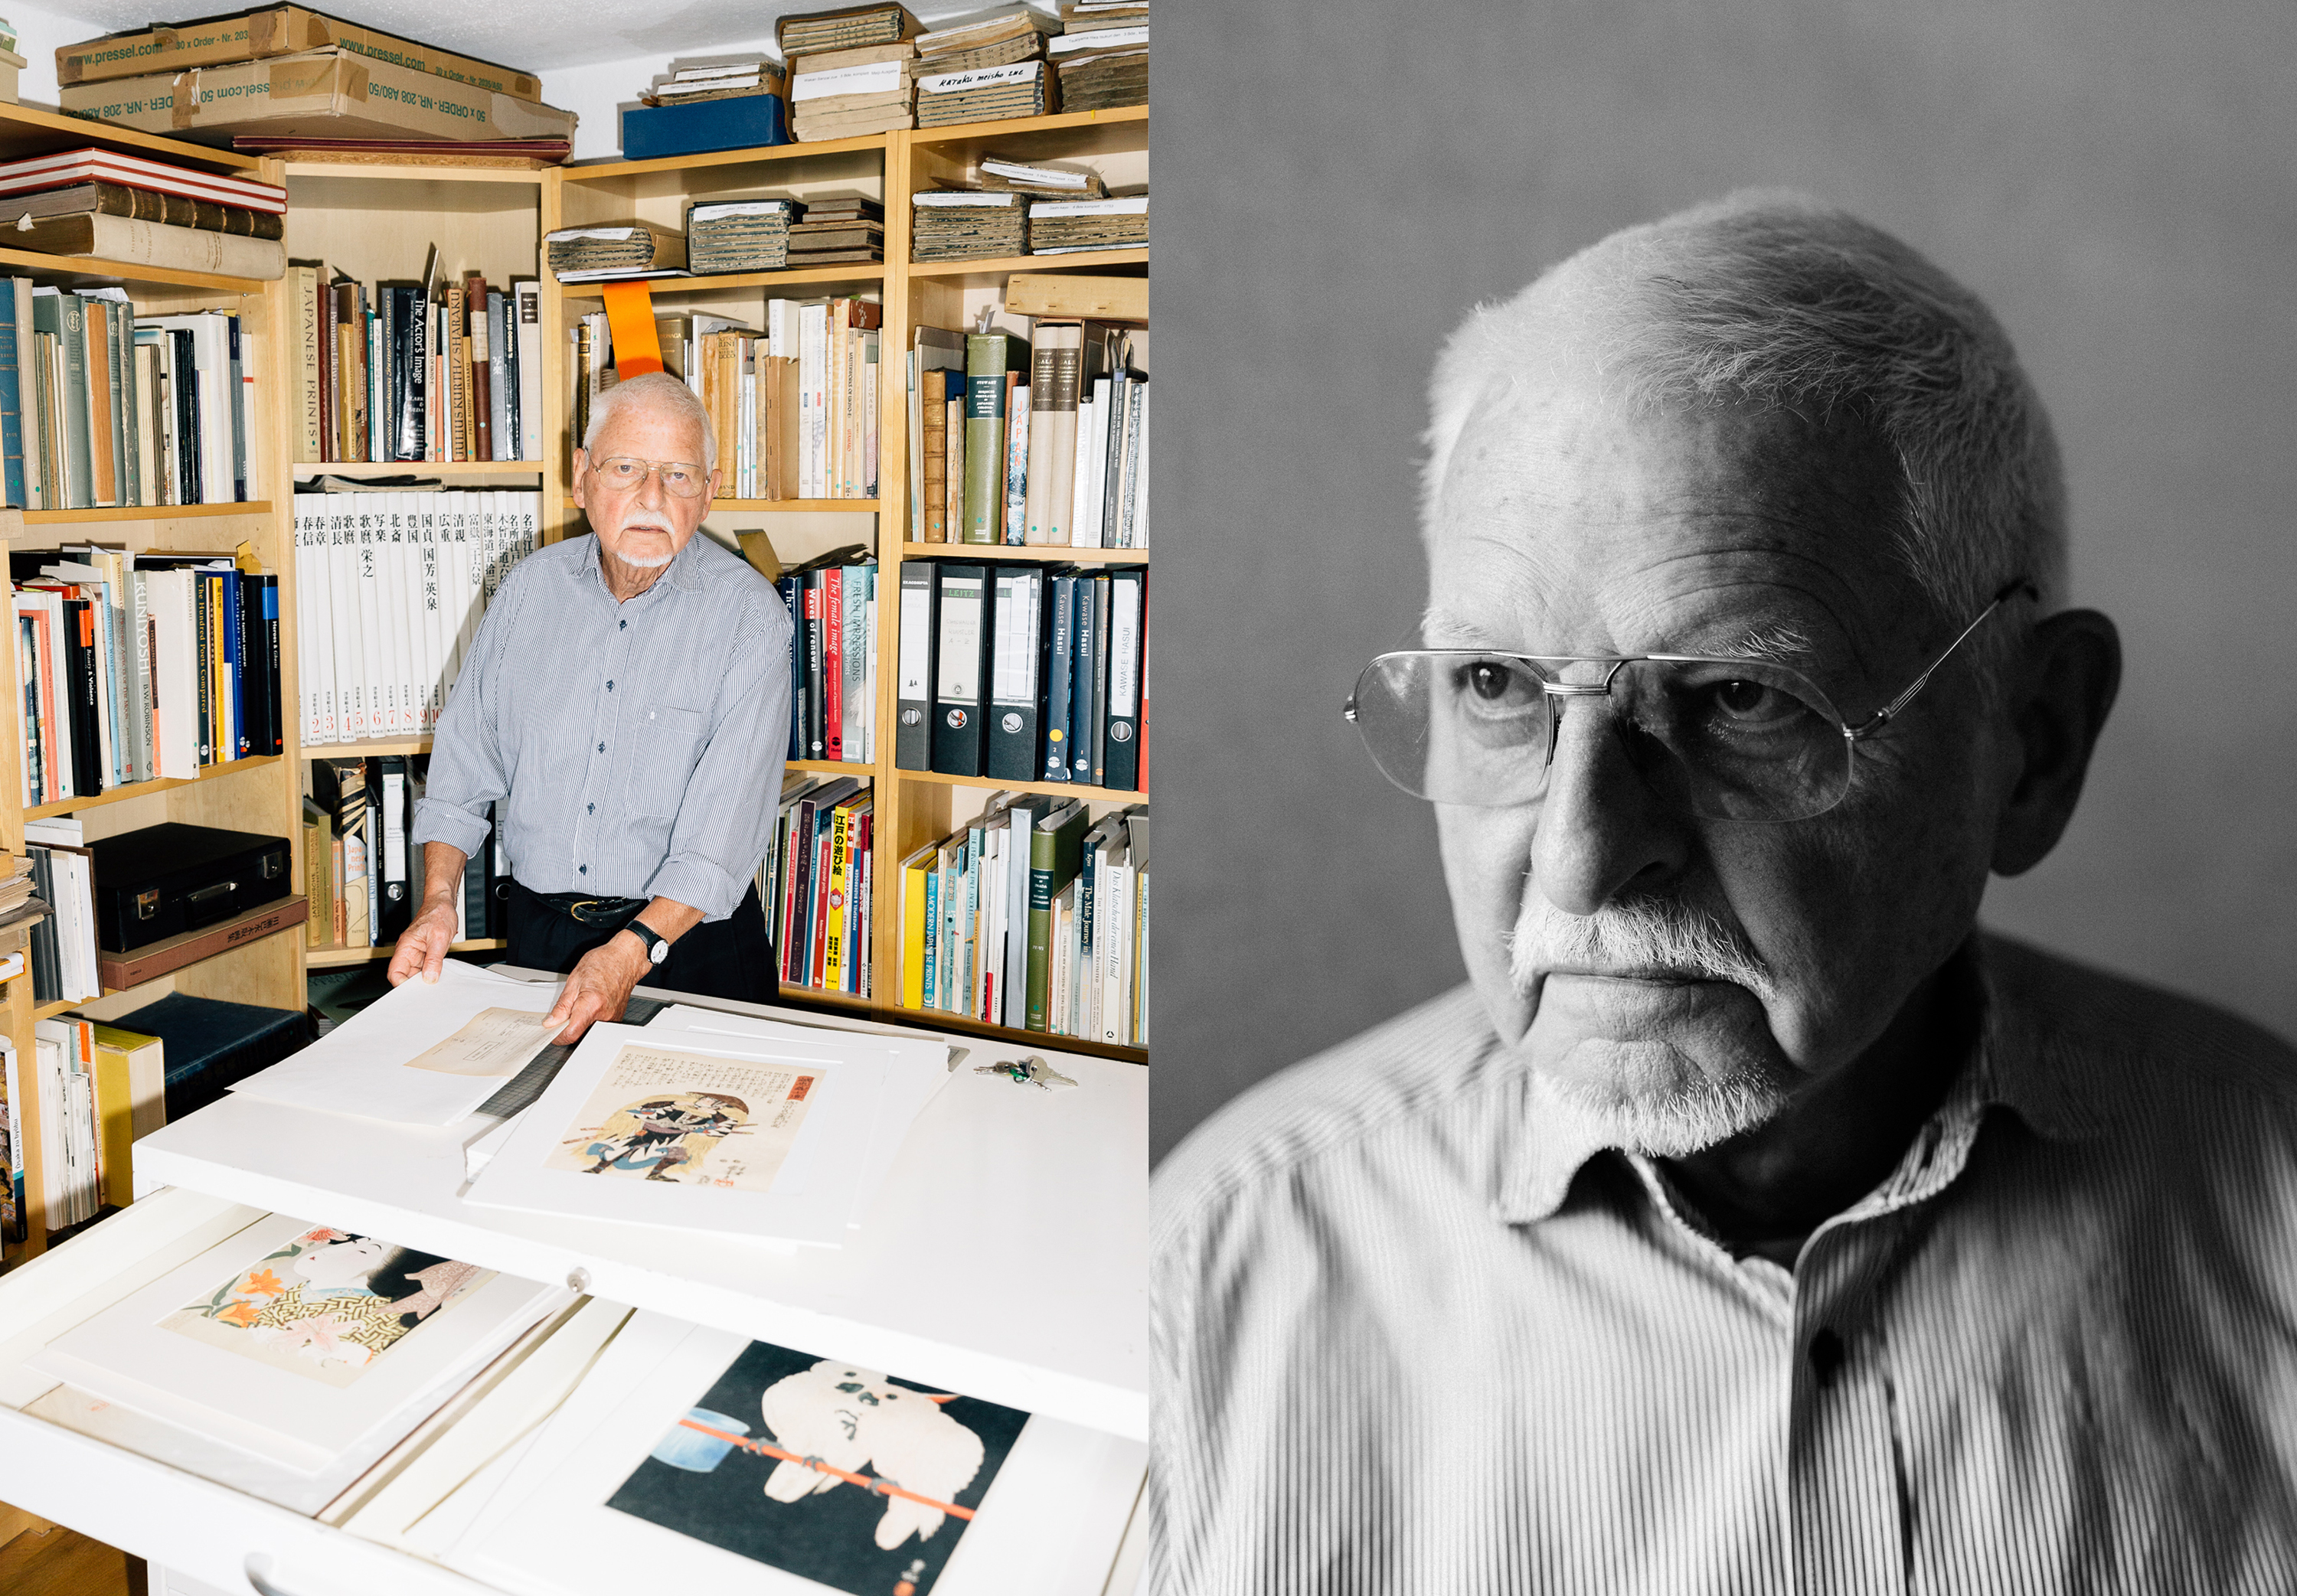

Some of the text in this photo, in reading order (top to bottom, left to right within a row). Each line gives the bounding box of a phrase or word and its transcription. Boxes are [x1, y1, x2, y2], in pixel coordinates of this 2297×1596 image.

[175, 33, 234, 51] 30 Order Nr.
[339, 38, 426, 71] www.pressel.com
[449, 69, 465, 82] Order
[976, 71, 1005, 82] meisho
[103, 103, 122, 117] 208
[201, 90, 214, 103] 50
[368, 82, 486, 122] 50 ORDER NR. 208 A80/50
[303, 286, 315, 370] JAPANESE
[413, 299, 425, 384] The Actor's Image
[451, 292, 464, 457] JULIUS KURTH SHARAKU
[307, 380, 318, 437] PRINTS
[1015, 400, 1023, 466] JAPAN
[302, 516, 314, 547] 春信
[314, 516, 327, 547] 春章
[330, 514, 343, 546] 清長
[343, 514, 355, 545] 歌麿
[374, 514, 387, 543] 写楽
[390, 513, 402, 543] 北斎
[407, 514, 419, 543] 豊国
[439, 513, 451, 543] 広重
[453, 513, 466, 543] 清親
[469, 513, 482, 586] 富嶽三十六景
[483, 512, 497, 599] 東海道五拾三次
[785, 588, 795, 608] The
[948, 589, 975, 598] LEITZ
[809, 622, 817, 632] of
[828, 577, 840, 655] The female image
[1056, 594, 1067, 655] Kawase Hasui
[1080, 596, 1090, 657] Kawase Hasui
[852, 581, 861, 682] FRESH IMPRESSIONS
[135, 582, 149, 676] KUNIYOSHI
[143, 703, 152, 746] ROBINSON
[810, 635, 818, 671] renewal
[1119, 627, 1130, 697] KAWASE HASUI
[312, 718, 320, 733] 2
[326, 715, 334, 731] 3
[344, 716, 351, 731] 4
[355, 711, 364, 726] 5
[373, 710, 381, 726] 6
[388, 709, 395, 725] 7
[404, 708, 413, 724] 8
[420, 708, 428, 724] 9
[832, 814, 846, 876] 江戸の遊び絵
[1085, 853, 1093, 867] Keyes
[1113, 870, 1122, 886] Das
[1084, 886, 1093, 900] The
[1112, 886, 1121, 922] Klatschen
[926, 894, 935, 929] MODERN
[1083, 900, 1092, 919] Male
[1082, 919, 1091, 944] Journey
[1111, 922, 1120, 935] der
[926, 930, 934, 964] JAPANESE
[1110, 935, 1119, 955] einen
[1081, 954, 1090, 982] Japanese
[1109, 955, 1119, 979] Hand
[14, 1139, 20, 1147] zu
